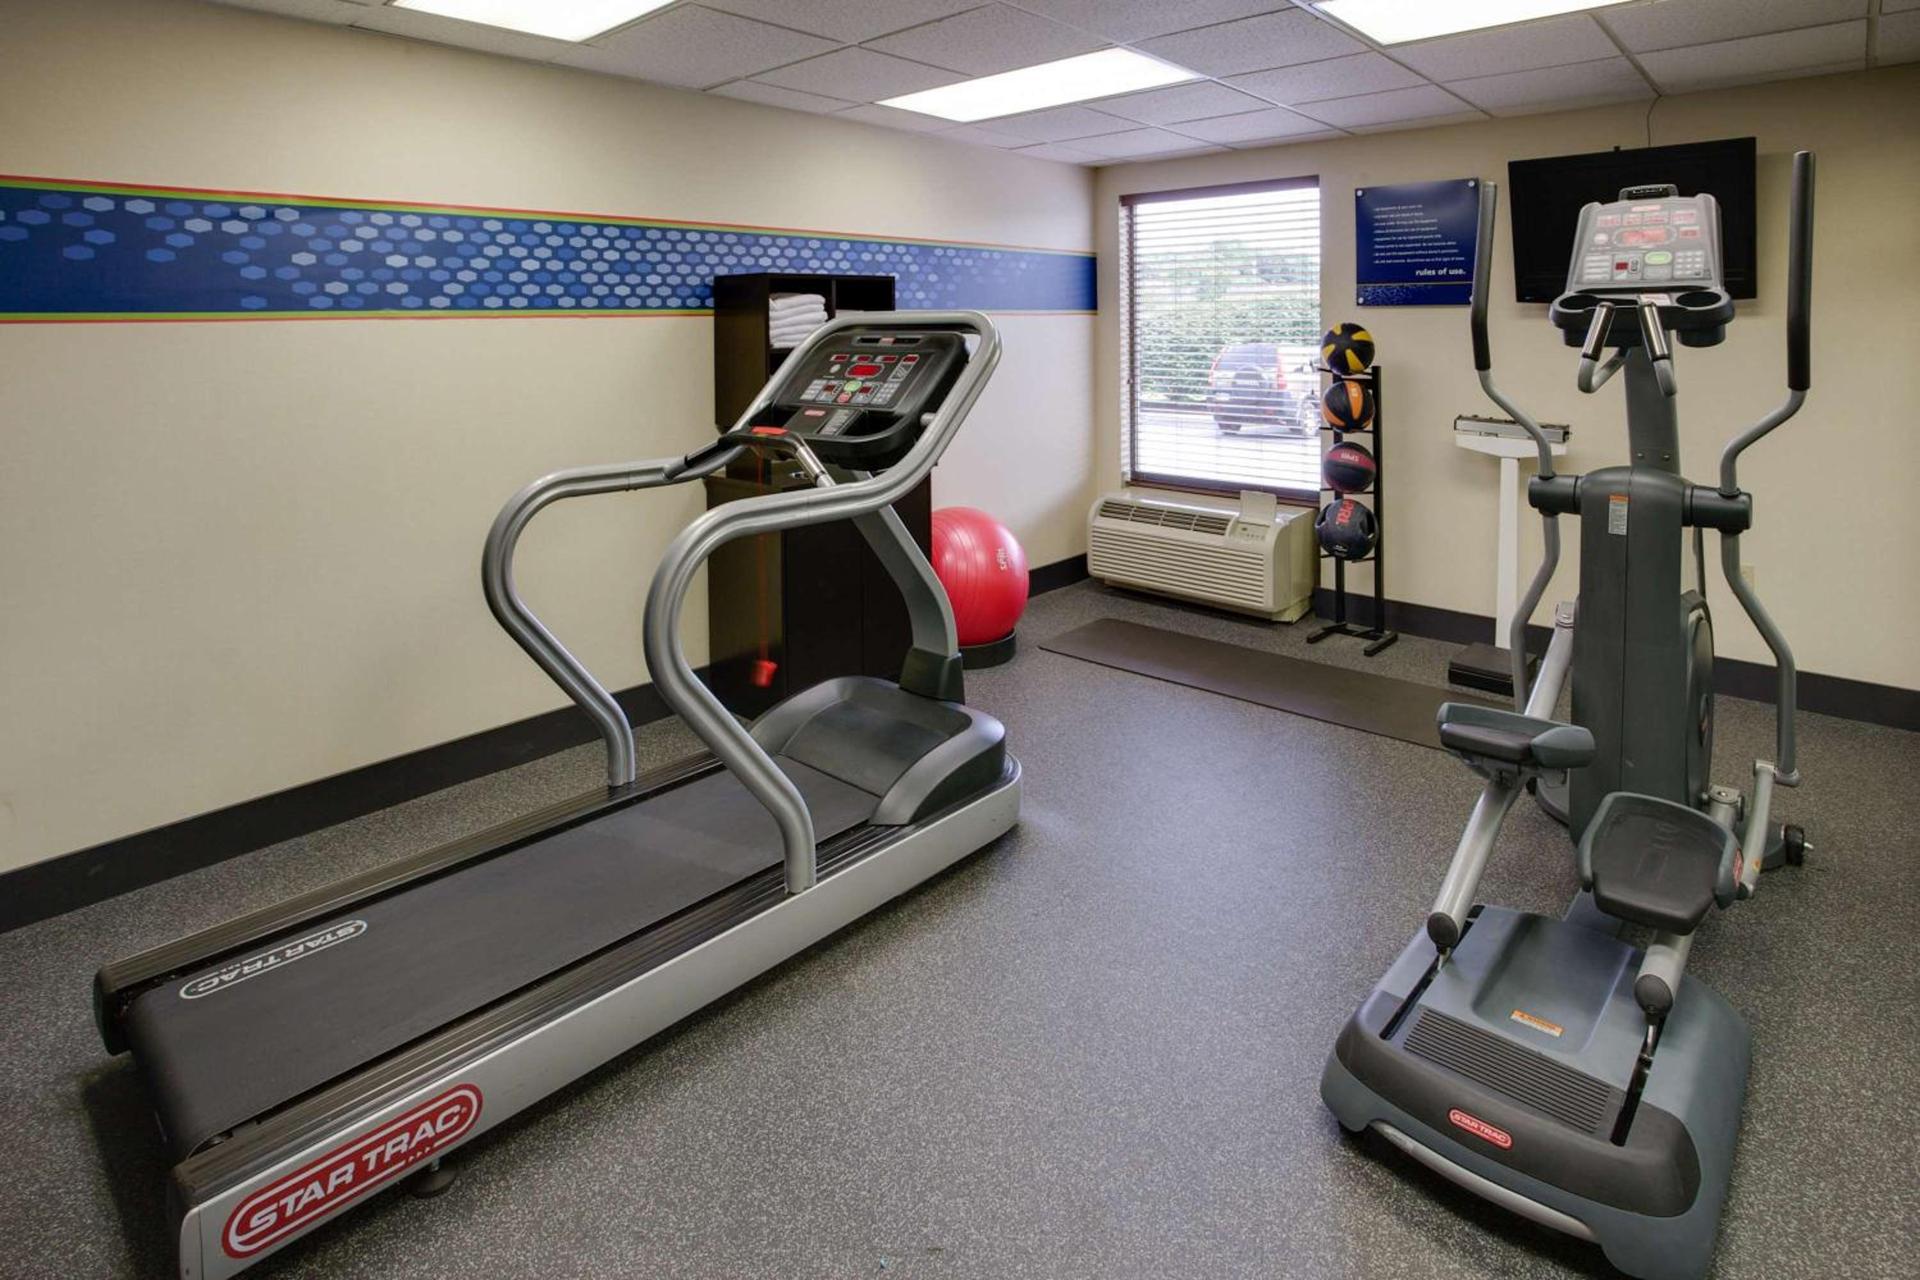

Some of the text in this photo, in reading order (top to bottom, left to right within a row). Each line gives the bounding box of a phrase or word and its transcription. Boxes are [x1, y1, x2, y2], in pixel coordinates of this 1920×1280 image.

[1415, 267, 1436, 276] rules
[1438, 267, 1447, 276] of
[197, 926, 356, 992] STAR TRAC
[1454, 1113, 1507, 1142] STAR TRAC
[249, 1103, 462, 1229] STAR TRAC
